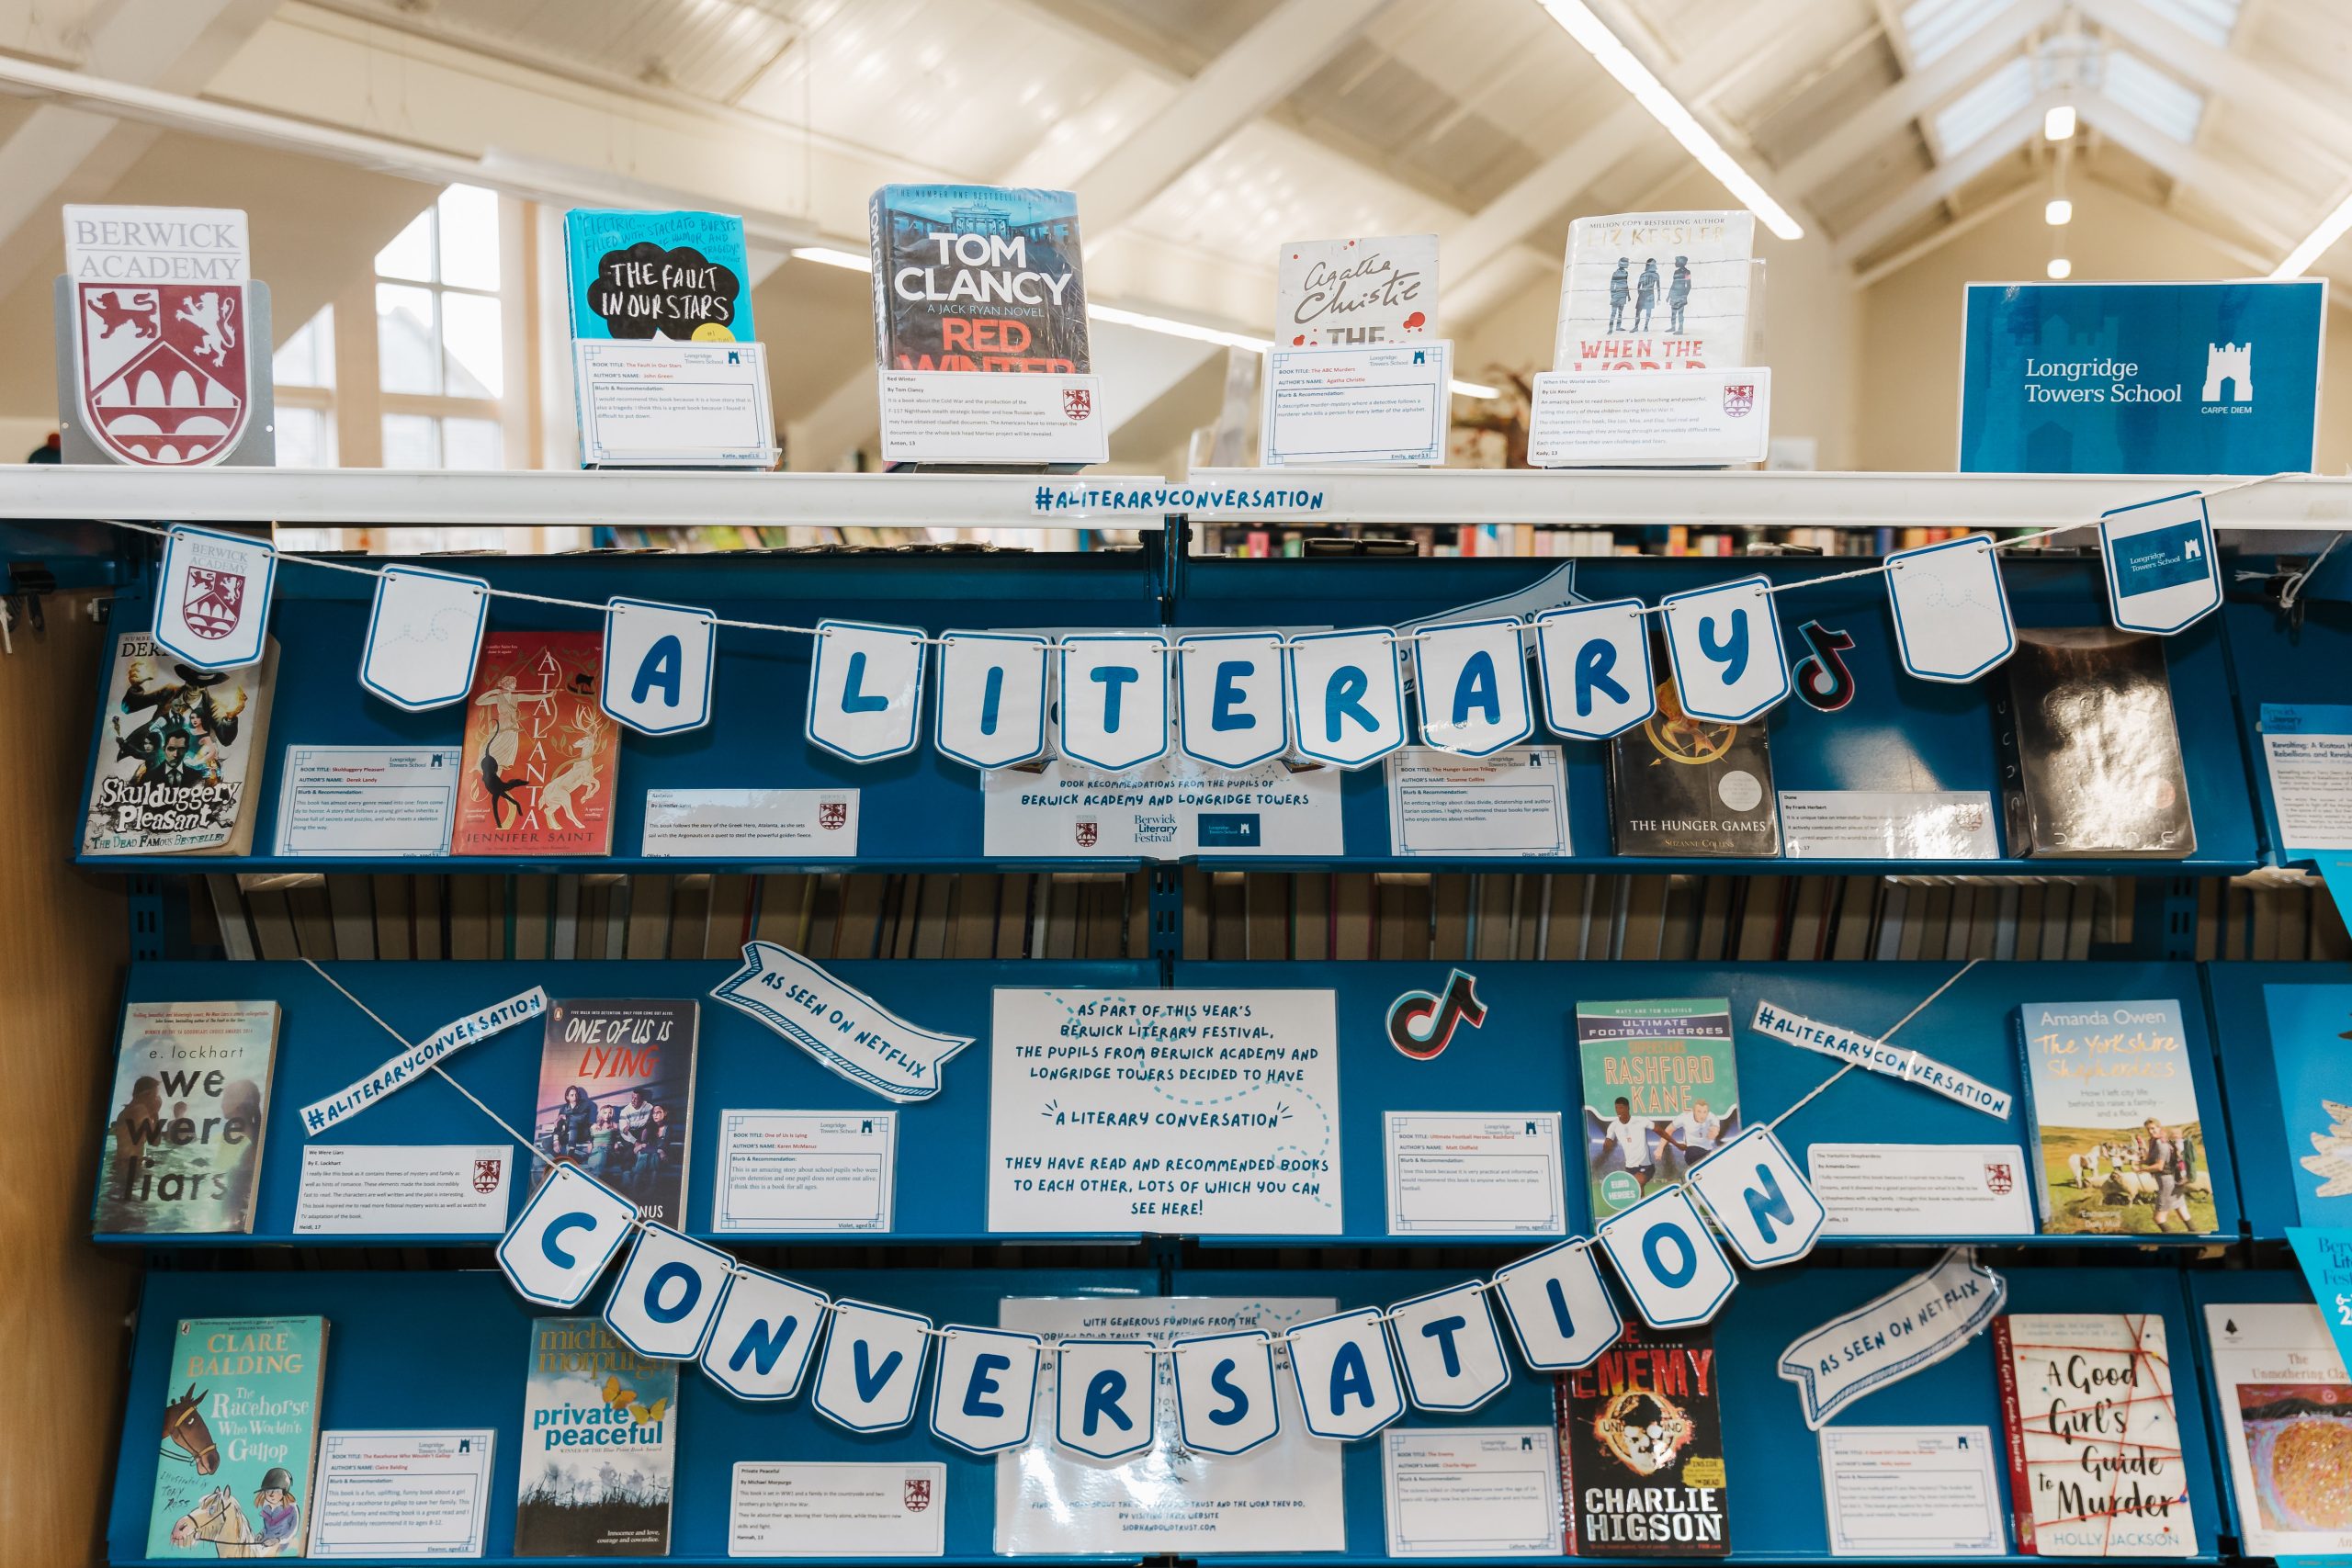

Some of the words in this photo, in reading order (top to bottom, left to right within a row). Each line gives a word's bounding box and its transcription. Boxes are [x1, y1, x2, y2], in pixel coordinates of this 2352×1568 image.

[75, 220, 238, 249] BERWICK
[1589, 220, 1620, 229] MILLION
[1645, 219, 1690, 227] BESTSELLING
[929, 232, 1027, 268] TOM
[80, 255, 241, 280] ACADEMY
[610, 262, 658, 288] THE
[662, 265, 718, 292] FAULT
[1304, 254, 1390, 291] Agatha
[894, 266, 1073, 306] CLANCY
[1294, 270, 1421, 324] Christie
[603, 292, 624, 316] IN
[628, 294, 663, 320] OUR
[666, 295, 729, 321] STARS
[927, 304, 935, 313] A
[939, 304, 966, 314] JACK
[969, 305, 1001, 316] RYAN
[1004, 307, 1045, 318] NOVEL
[942, 317, 1032, 354] RED
[1580, 339, 1653, 359] WHEN
[1662, 340, 1703, 357] THE
[2026, 358, 2138, 381] Longridge
[2025, 384, 2105, 403] Towers
[2110, 383, 2182, 403] School
[2201, 406, 2229, 414] CARPE
[2231, 406, 2252, 414] DIEM
[1035, 486, 1323, 511] #ALITERARYCONVERSATION
[191, 543, 248, 562] BERWICK
[2130, 551, 2165, 565] Longridge
[2131, 561, 2156, 572] Towers
[2157, 556, 2181, 567] School
[189, 557, 246, 575] ACADEMY
[631, 635, 682, 707] A
[520, 651, 556, 830] ATALANTA
[100, 777, 242, 811] Skulduggery
[1059, 780, 1084, 788] BOOK
[1088, 780, 1175, 789] RECOMMENDATIONS
[1178, 780, 1204, 788] FROM
[1207, 780, 1224, 788] THE
[1227, 780, 1259, 788] PUPILS
[1261, 780, 1273, 788] OF
[1022, 795, 1079, 806] BERWICK
[1083, 794, 1143, 806] ACADEMY
[1148, 795, 1173, 806] AND
[1179, 794, 1251, 806] LONGRIDGE
[1256, 794, 1309, 805] TOWERS
[117, 805, 211, 831] Pleasant
[1135, 815, 1176, 825] Berwick
[1139, 824, 1177, 835] Literary
[1631, 820, 1657, 830] THE
[1662, 820, 1719, 831] HUNGER
[1722, 821, 1766, 831] GAMES
[467, 833, 538, 842] JENNIFER
[548, 832, 594, 842] SAINT
[1135, 833, 1171, 843] Festival
[1078, 1005, 1094, 1016] AS
[1100, 1005, 1136, 1017] PART
[1143, 1005, 1161, 1017] OF
[1166, 1005, 1197, 1017] THIS
[1203, 1005, 1251, 1017] YEAR'S
[2041, 1010, 2109, 1026] Amanda
[2113, 1010, 2165, 1025] Owen
[565, 1018, 607, 1043] ONE
[606, 1019, 631, 1043] OF
[631, 1020, 655, 1044] US
[657, 1021, 673, 1042] IS
[762, 973, 785, 989] AS
[786, 985, 827, 1016] SEEN
[830, 1010, 855, 1033] ON
[854, 1031, 926, 1078] NETFLIX
[1060, 1025, 1123, 1037] BERWICK
[1129, 1026, 1197, 1039] LITERARY
[1203, 1026, 1273, 1039] FESTIVAL,
[149, 1048, 164, 1059] e.
[172, 1046, 243, 1058] lockhart
[1016, 1046, 1042, 1057] THE
[1048, 1046, 1099, 1058] PUPILS
[1104, 1047, 1145, 1058] FROM
[1150, 1047, 1214, 1059] BERWICK
[1219, 1048, 1284, 1060] ACADEMY
[1292, 1049, 1318, 1060] AND
[2034, 1033, 2080, 1055] The
[2084, 1032, 2179, 1056] Yorkshire
[308, 994, 540, 1129] #ALITERARYCONVERSATION
[579, 1045, 660, 1079] LYING
[1604, 1055, 1714, 1085] RASHFORD
[1758, 1006, 2004, 1112] #ALITERARYCONVERSATION
[160, 1069, 225, 1098] we
[1030, 1067, 1111, 1079] LONGRIDGE
[1117, 1068, 1174, 1080] TOWERS
[1180, 1069, 1238, 1080] DECIDED
[1244, 1069, 1261, 1080] TO
[1267, 1069, 1304, 1082] HAVE
[1631, 1085, 1693, 1113] KANE
[126, 1117, 246, 1145] were
[1056, 1112, 1066, 1125] A
[1071, 1112, 1148, 1125] LITERARY
[1155, 1113, 1278, 1128] CONVERSATION
[1005, 1157, 1042, 1169] THEY
[1047, 1157, 1085, 1169] HAVE
[1091, 1158, 1126, 1170] READ
[1133, 1158, 1160, 1170] AND
[1166, 1158, 1274, 1172] RECOMMENDED
[1281, 1159, 1329, 1172] BOOKS
[125, 1156, 229, 1201] liars
[1131, 1202, 1156, 1214] SEE
[1161, 1200, 1204, 1215] HERE!
[1083, 1318, 1107, 1326] WITH
[1110, 1317, 1160, 1326] GENEROUS
[1163, 1317, 1205, 1326] FUNDING
[1208, 1316, 1236, 1327] FROM
[1239, 1316, 1257, 1325] THE
[1820, 1354, 1839, 1376] AS
[1843, 1332, 1886, 1361] SEEN
[1889, 1317, 1914, 1337] ON
[1918, 1280, 1979, 1325] NETFLIX
[208, 1333, 288, 1353] CLARE
[187, 1354, 304, 1377] BALDING
[2288, 1353, 2308, 1365] The
[2047, 1360, 2062, 1386] A
[2068, 1354, 2138, 1394] Good
[2252, 1368, 2324, 1380] Unmothering
[211, 1393, 310, 1418] Racehorse
[235, 1387, 255, 1400] The
[218, 1421, 247, 1435] Who
[249, 1420, 302, 1436] Wouldn't
[534, 1403, 629, 1430] private
[2049, 1398, 2127, 1445] Girl's
[545, 1421, 662, 1450] peaceful
[228, 1438, 288, 1462] Gallop
[2082, 1445, 2164, 1482] Guide
[1586, 1487, 1719, 1513] CHARLIE
[2038, 1472, 2053, 1492] to
[2058, 1481, 2174, 1522] Murder
[1587, 1514, 1723, 1541] HIGSON
[2054, 1533, 2102, 1546] HOLLY
[2110, 1534, 2179, 1546] JACKSON
